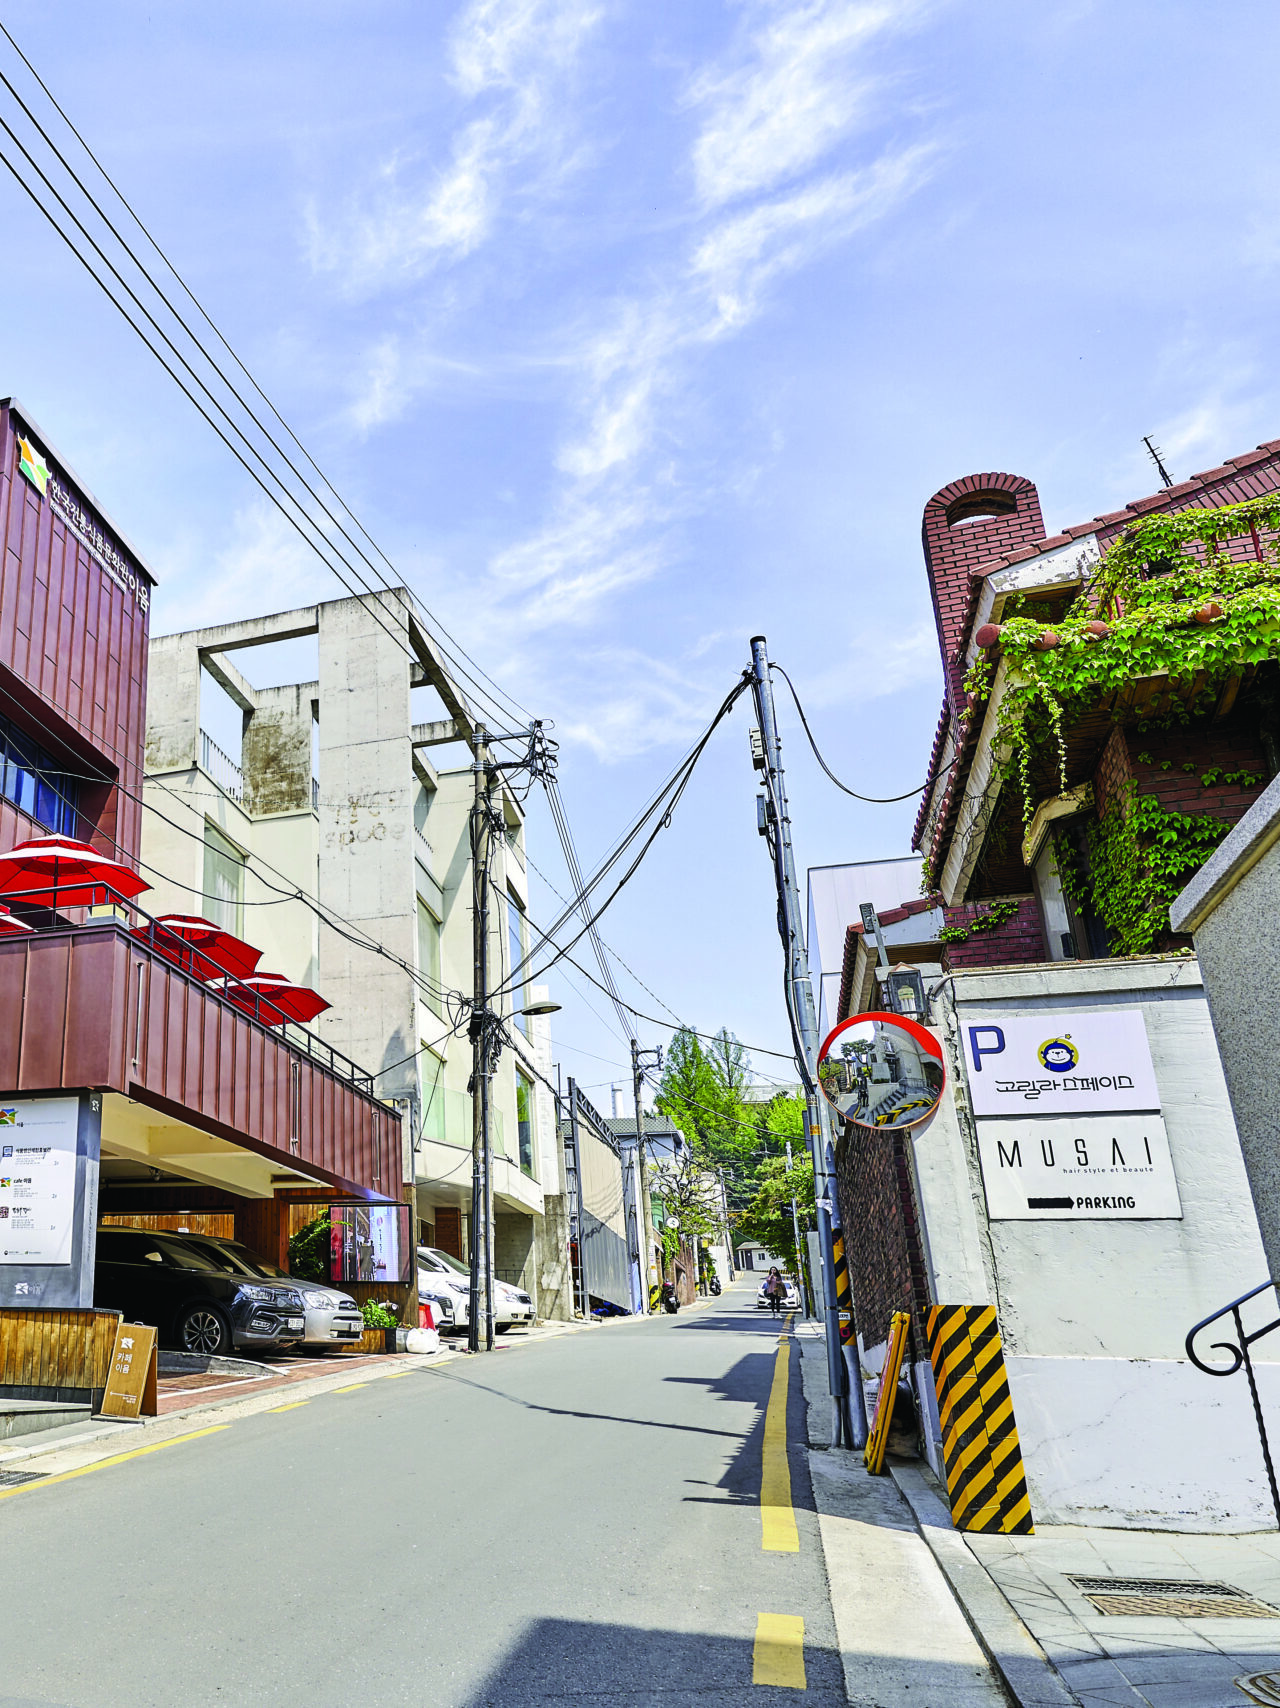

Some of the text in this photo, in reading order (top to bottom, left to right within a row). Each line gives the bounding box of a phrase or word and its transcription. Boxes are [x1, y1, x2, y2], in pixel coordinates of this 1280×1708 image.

[52, 480, 129, 582] 한국전통식품문화관
[128, 574, 149, 614] 이음
[968, 1026, 1006, 1072] P
[998, 1137, 1152, 1168] MUSAI
[1076, 1196, 1136, 1209] PARKING
[117, 1352, 133, 1363] 카페
